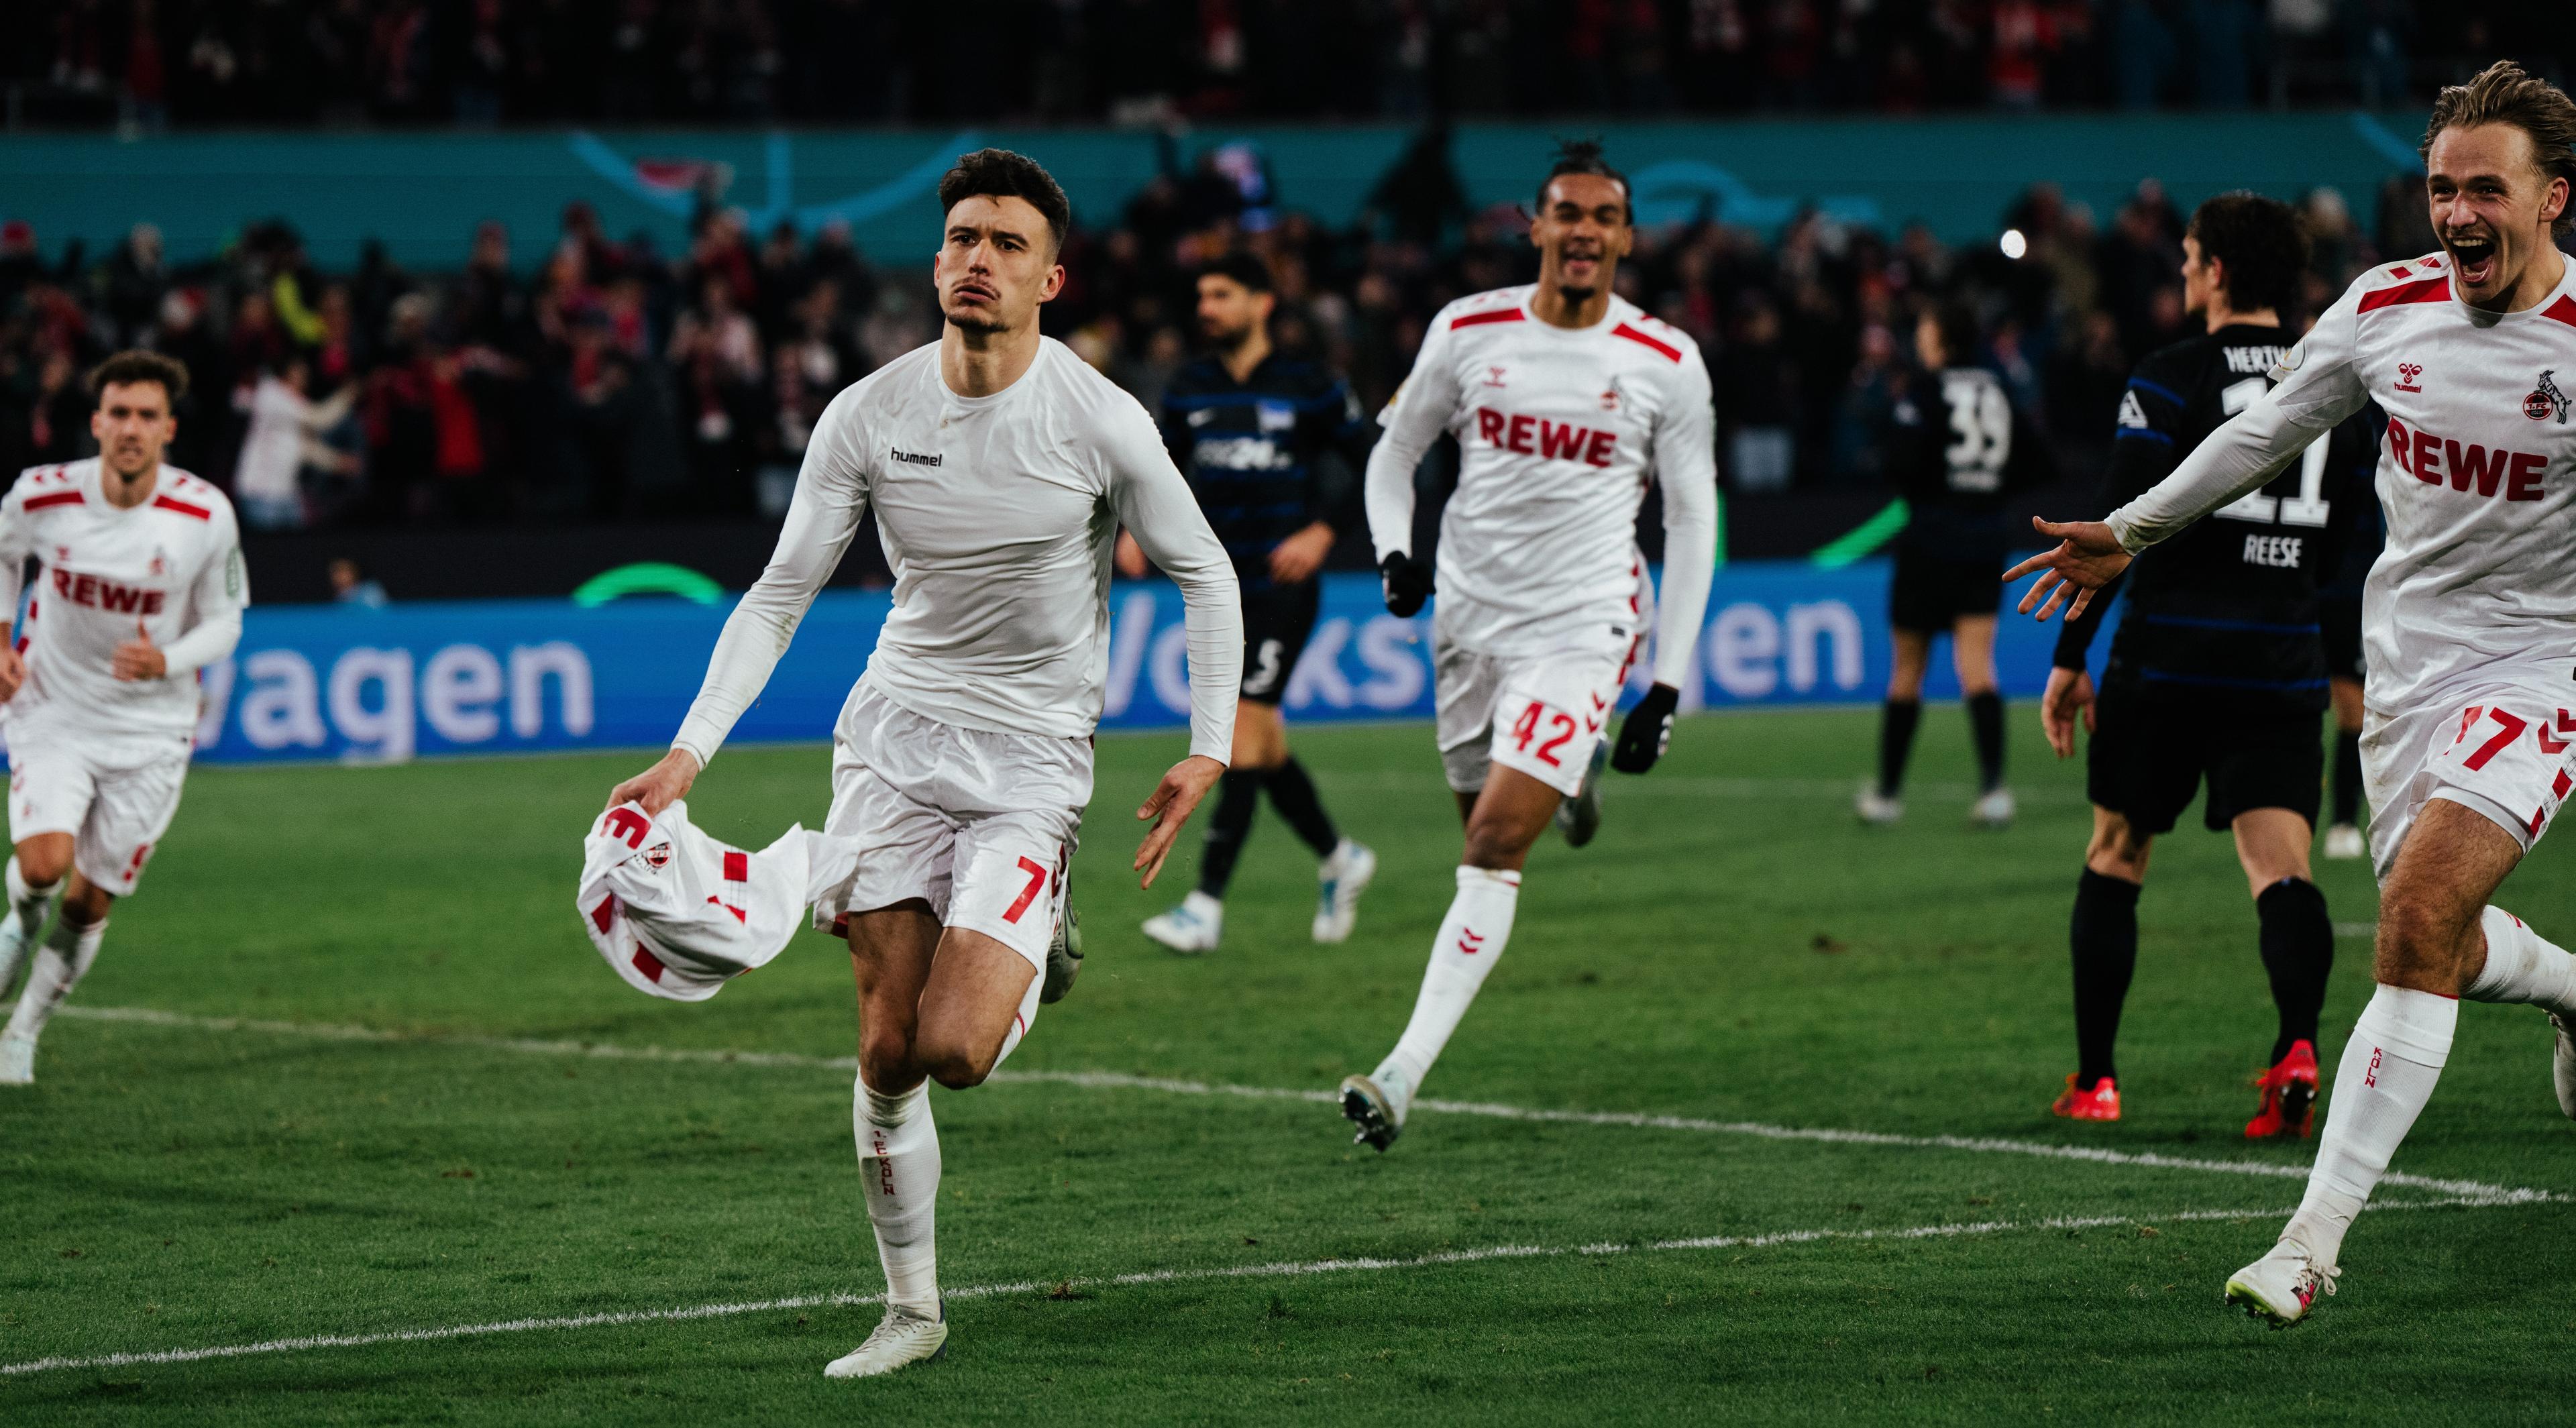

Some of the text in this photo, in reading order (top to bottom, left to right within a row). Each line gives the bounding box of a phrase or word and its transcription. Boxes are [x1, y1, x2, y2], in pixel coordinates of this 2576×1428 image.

[2394, 382, 2422, 393] hummel
[890, 446, 943, 468] hummel
[1478, 406, 1618, 468] REWE
[2387, 415, 2548, 502] REWE
[2243, 533, 2302, 569] REESE
[52, 567, 166, 616] REWE
[1511, 701, 1576, 768] 42
[1002, 855, 1047, 925] 7
[2365, 1047, 2383, 1089] KÖLN
